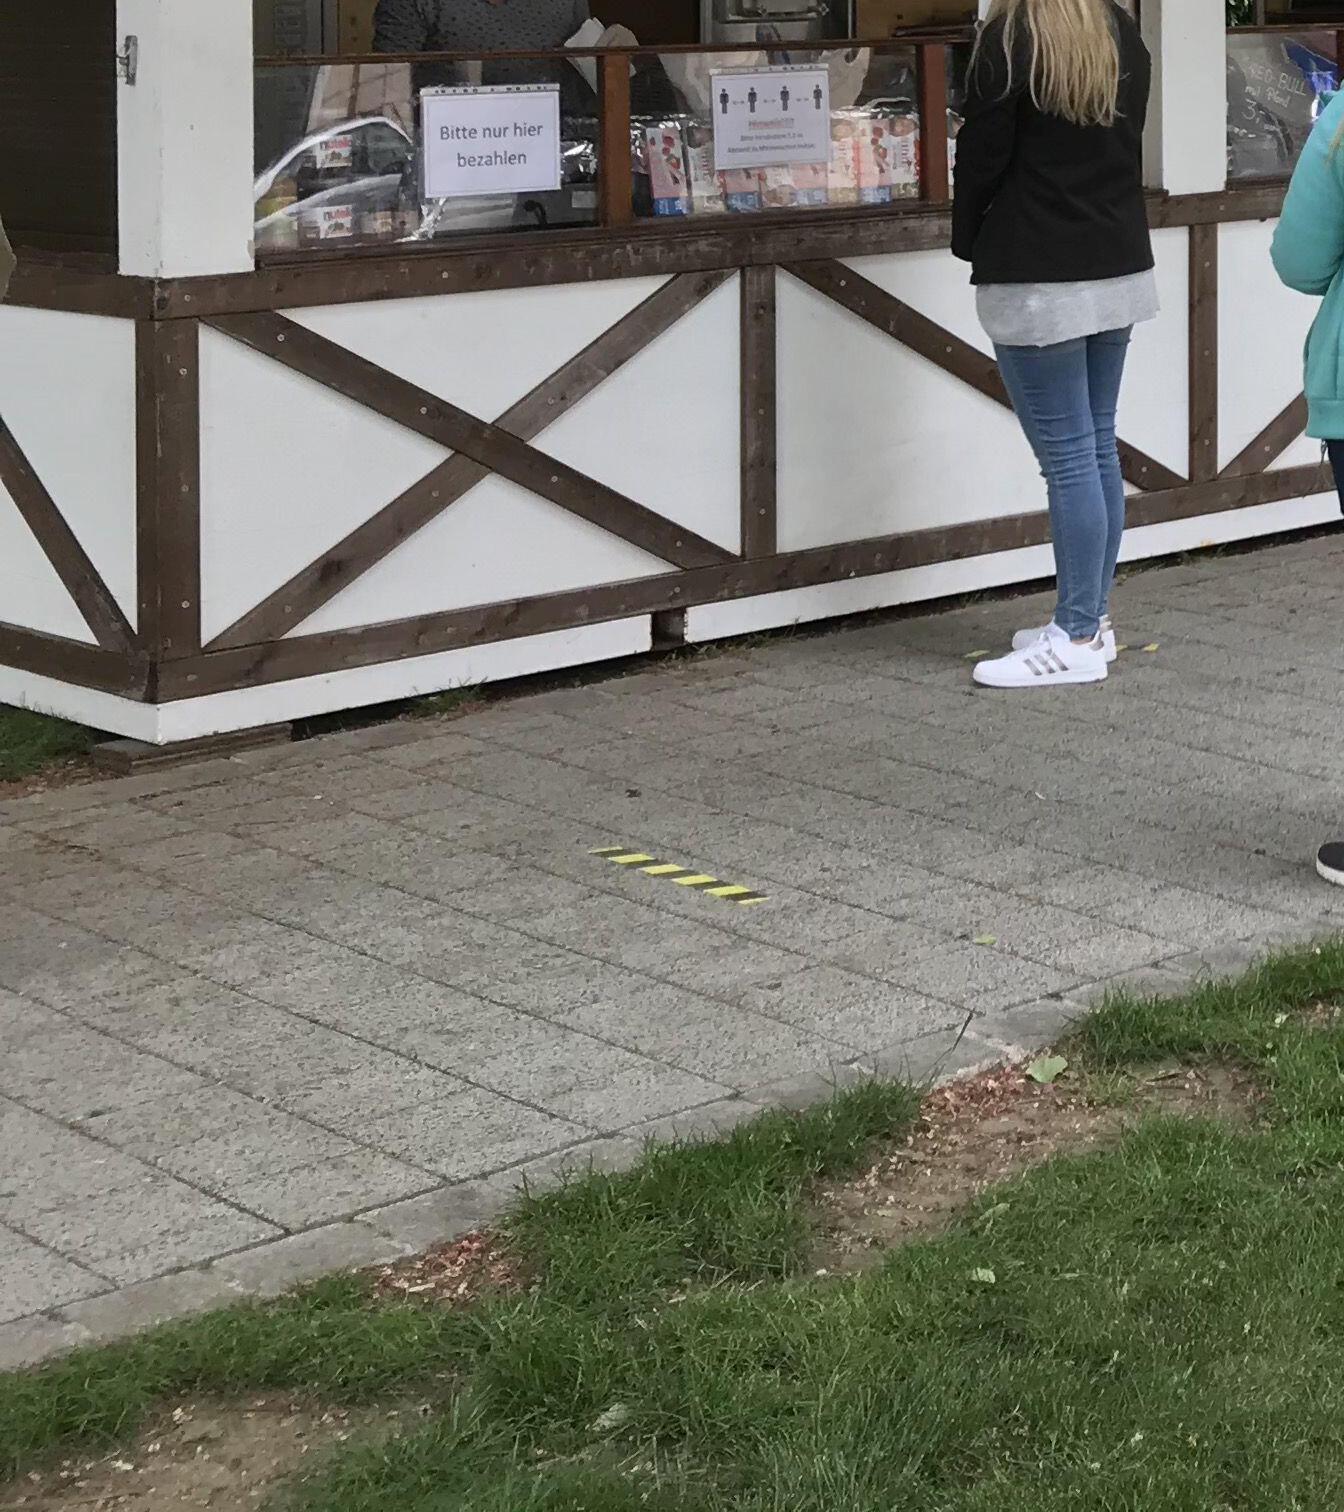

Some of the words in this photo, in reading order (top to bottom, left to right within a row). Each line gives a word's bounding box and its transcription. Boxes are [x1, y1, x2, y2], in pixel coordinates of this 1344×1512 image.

[440, 126, 478, 141] Bitte
[482, 127, 510, 139] nur
[512, 122, 543, 137] hier
[457, 151, 527, 168] bezahlen
